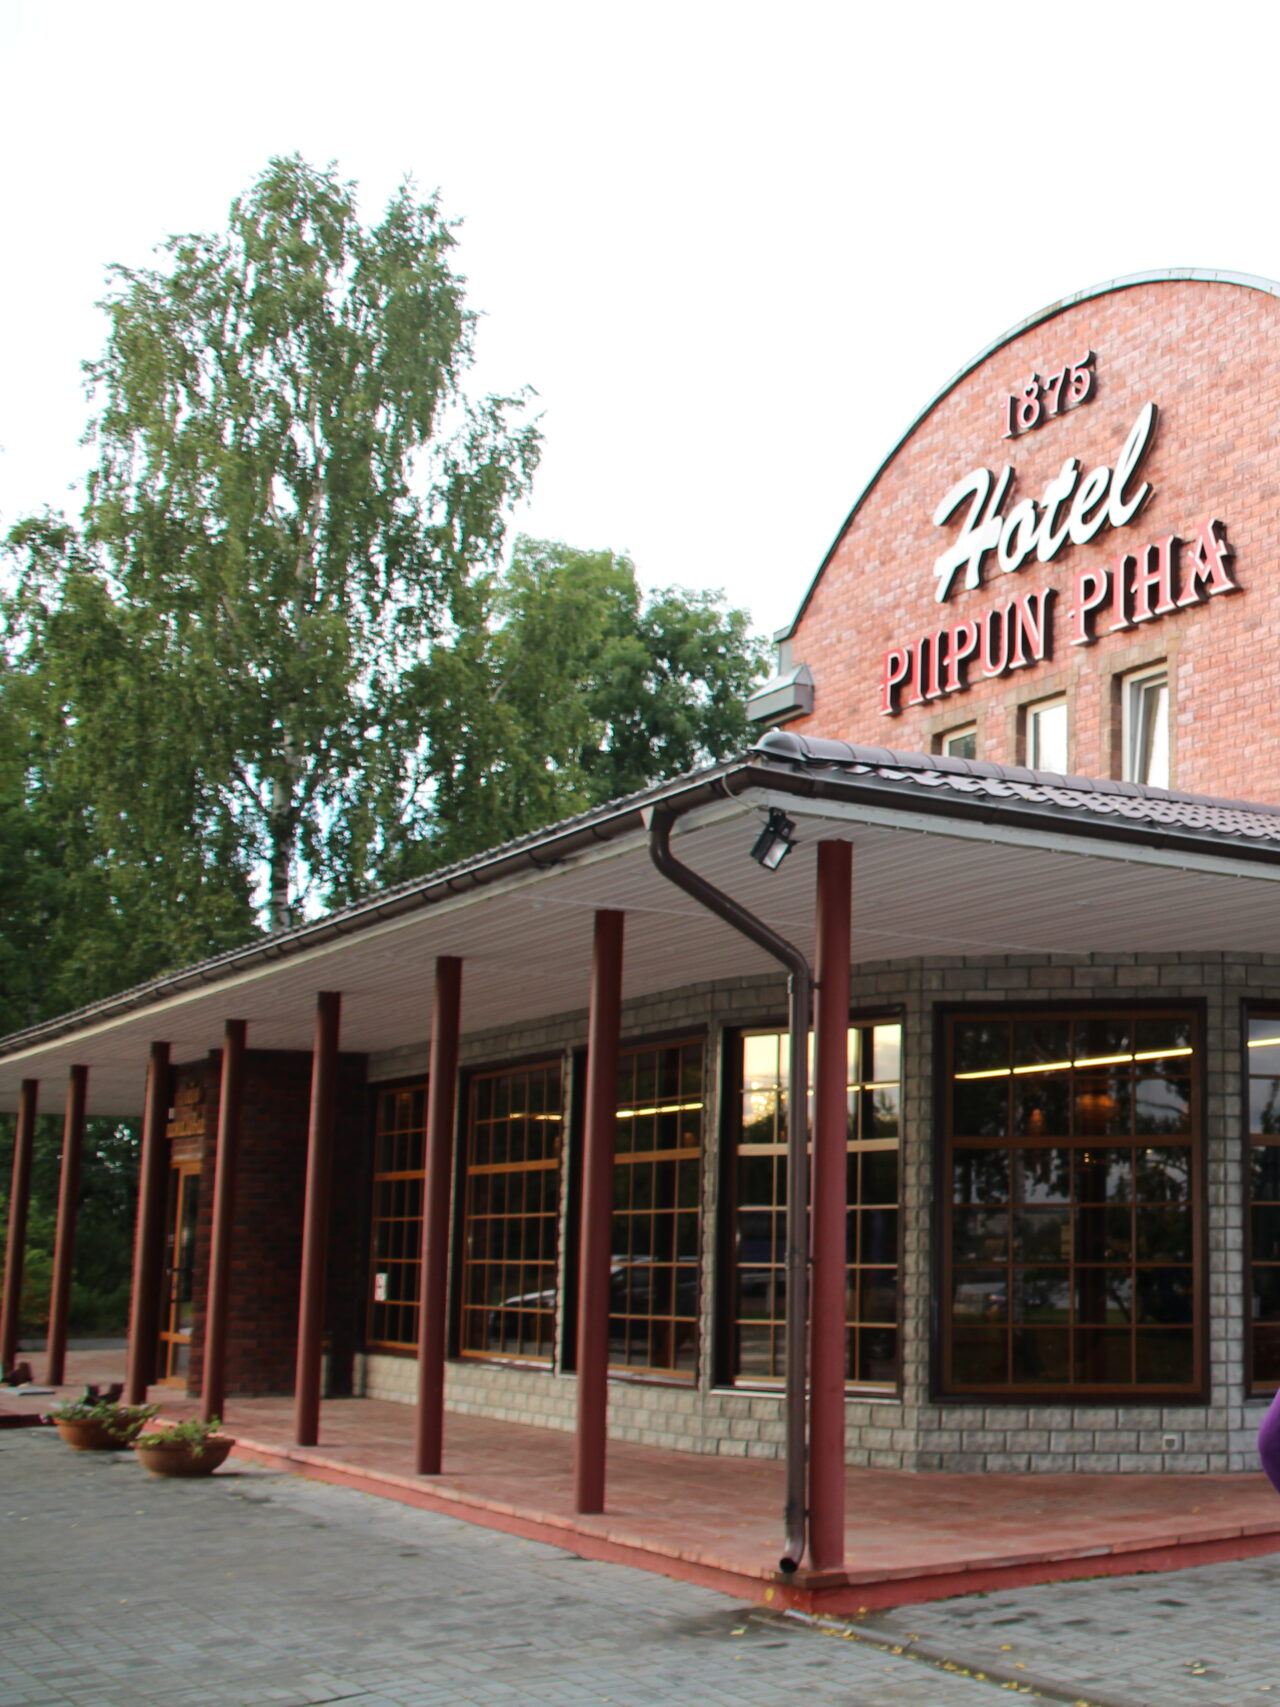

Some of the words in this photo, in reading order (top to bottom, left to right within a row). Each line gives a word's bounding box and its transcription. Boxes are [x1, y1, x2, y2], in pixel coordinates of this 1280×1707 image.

[1000, 351, 1095, 438] 1875
[932, 402, 1157, 602] Hotel
[879, 588, 1058, 715] PIIPUN
[1068, 519, 1242, 645] PIHA
